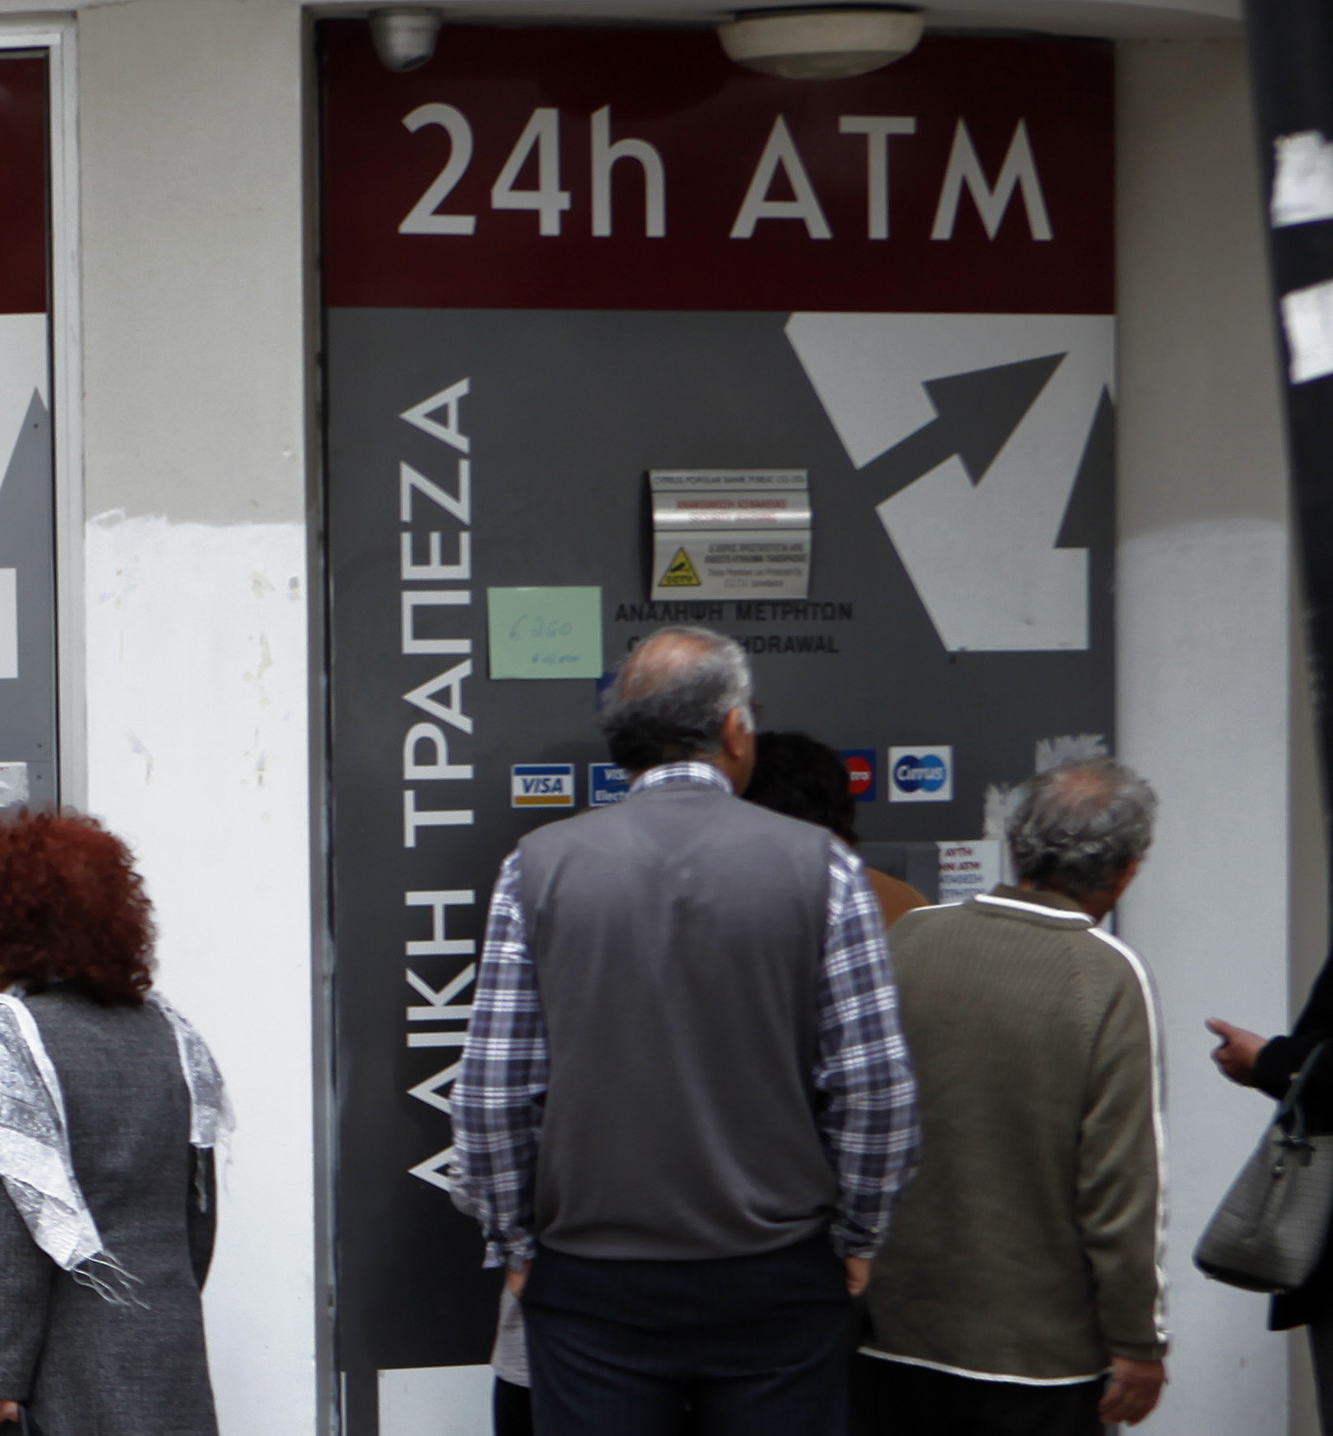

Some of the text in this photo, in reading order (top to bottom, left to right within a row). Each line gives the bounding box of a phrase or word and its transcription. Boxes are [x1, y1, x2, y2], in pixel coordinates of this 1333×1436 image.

[398, 103, 1053, 241] 24h ATM
[401, 378, 474, 848] ΤΡΑΠΕΖΑ
[615, 602, 854, 622] ΑΝΑΛΗΨΗ ΜΕΤΡΗΤΩΝ
[744, 635, 840, 655] HDRAWAL
[897, 765, 944, 781] Cirrus
[522, 778, 564, 794] VISA
